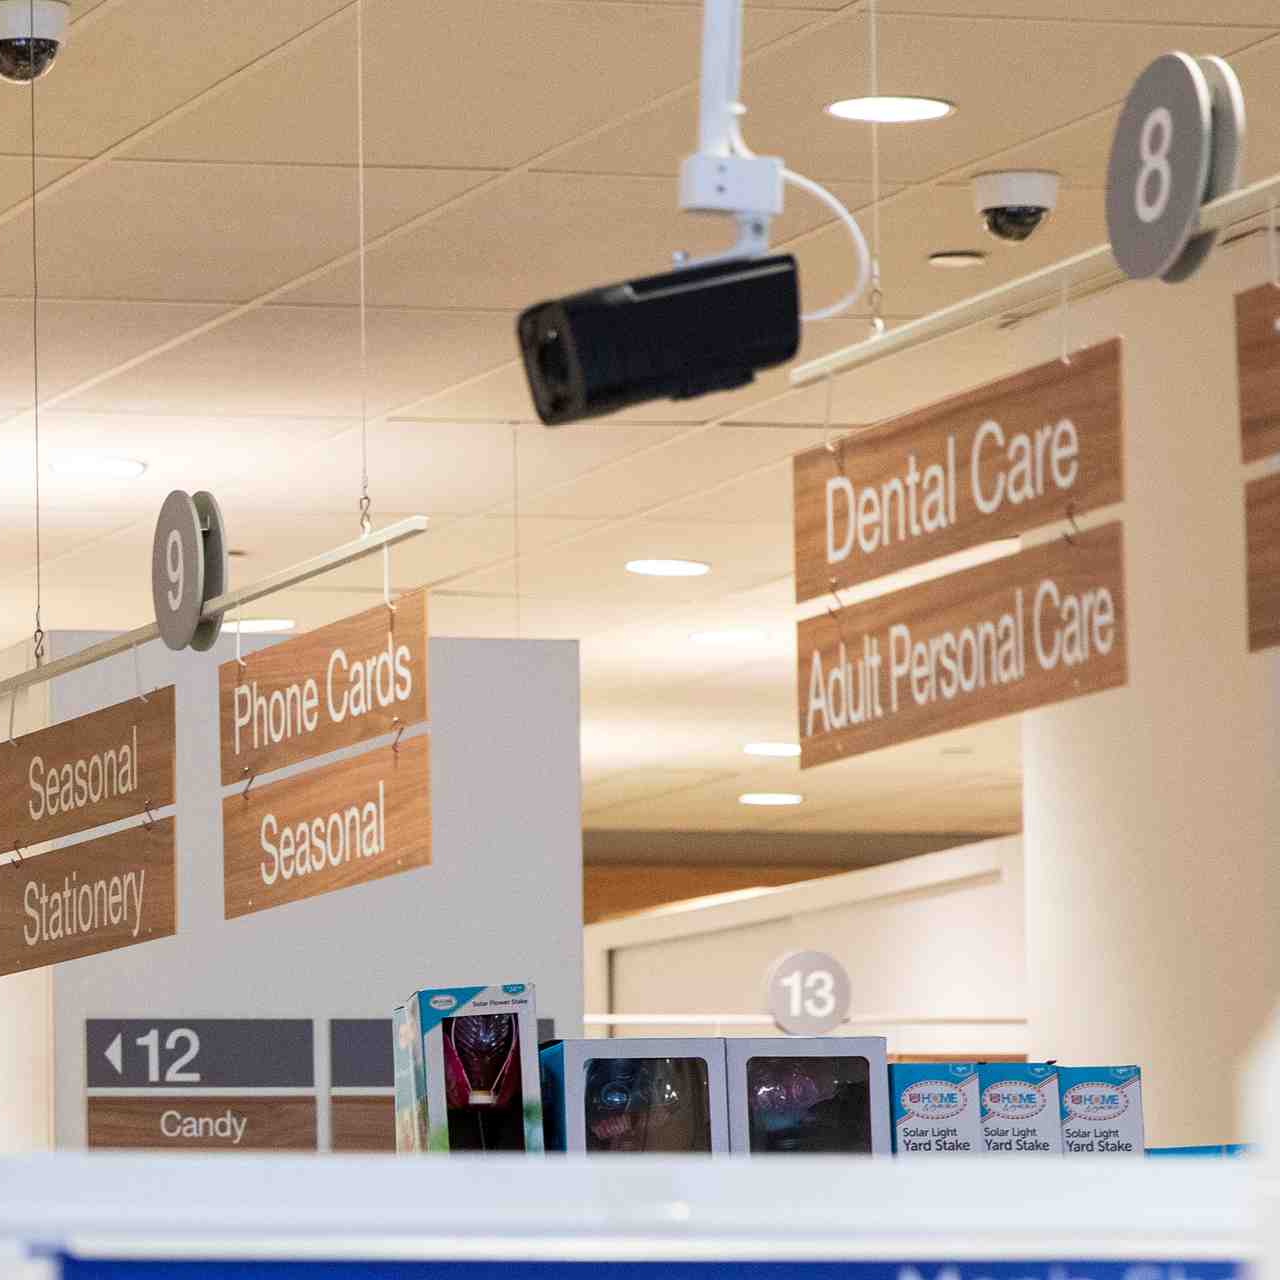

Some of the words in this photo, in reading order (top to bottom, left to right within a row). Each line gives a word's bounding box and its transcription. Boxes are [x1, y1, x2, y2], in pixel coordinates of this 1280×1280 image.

[1135, 106, 1172, 223] 8
[826, 434, 956, 565] Dental
[971, 418, 1078, 515] Care
[166, 529, 184, 611] 9
[807, 634, 883, 737] Adult
[889, 587, 1024, 715] Personal
[1033, 580, 1115, 670] Care
[234, 677, 318, 755] Phone
[327, 642, 413, 723] Cards
[28, 725, 138, 821] Seasonal
[260, 780, 384, 886] Seasonal
[23, 868, 145, 946] Stationery
[781, 971, 836, 1018] 13
[136, 1028, 201, 1083] 12
[159, 1110, 247, 1142] Candy
[903, 1127, 929, 1137] Solar
[931, 1127, 958, 1139] Light
[903, 1139, 932, 1151] Yard
[935, 1139, 971, 1152] Stake
[984, 1127, 1009, 1137] Solar
[1012, 1127, 1038, 1139] Light
[985, 1139, 1013, 1151] Yard
[1016, 1139, 1050, 1152] Stake
[1065, 1128, 1091, 1138] Solar
[1094, 1128, 1120, 1140] Light
[1066, 1140, 1094, 1152] Yard
[1098, 1140, 1133, 1152] Stake
